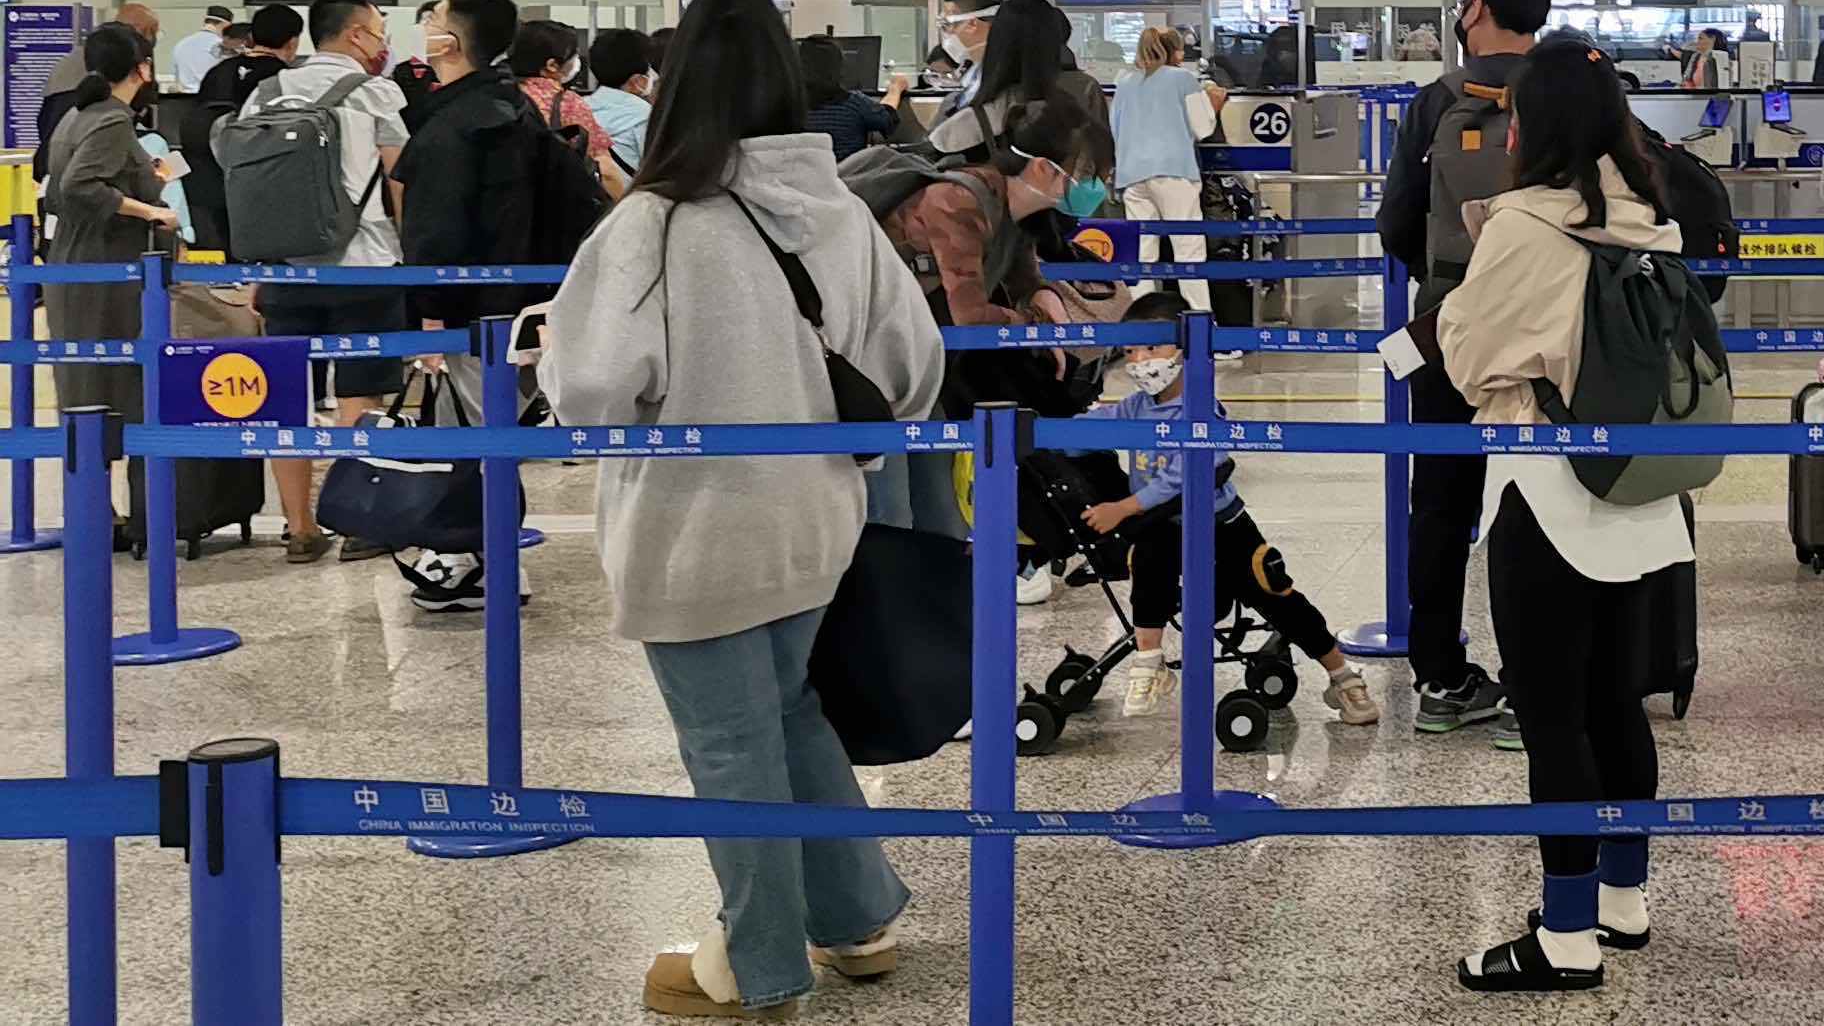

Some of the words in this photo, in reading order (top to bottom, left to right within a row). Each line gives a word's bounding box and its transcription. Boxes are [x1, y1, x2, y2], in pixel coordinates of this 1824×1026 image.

[1253, 112, 1287, 135] 26
[208, 375, 261, 397] ≥1M
[241, 429, 369, 447] 中国边检
[571, 427, 702, 446] 中国边检
[1156, 422, 1283, 440] 中国边检
[1482, 426, 1608, 443] 中国边检
[353, 785, 592, 818] 中国边检
[358, 819, 404, 831] CHINA
[509, 822, 596, 833] INSPECTION
[966, 812, 1213, 827] 中国边检
